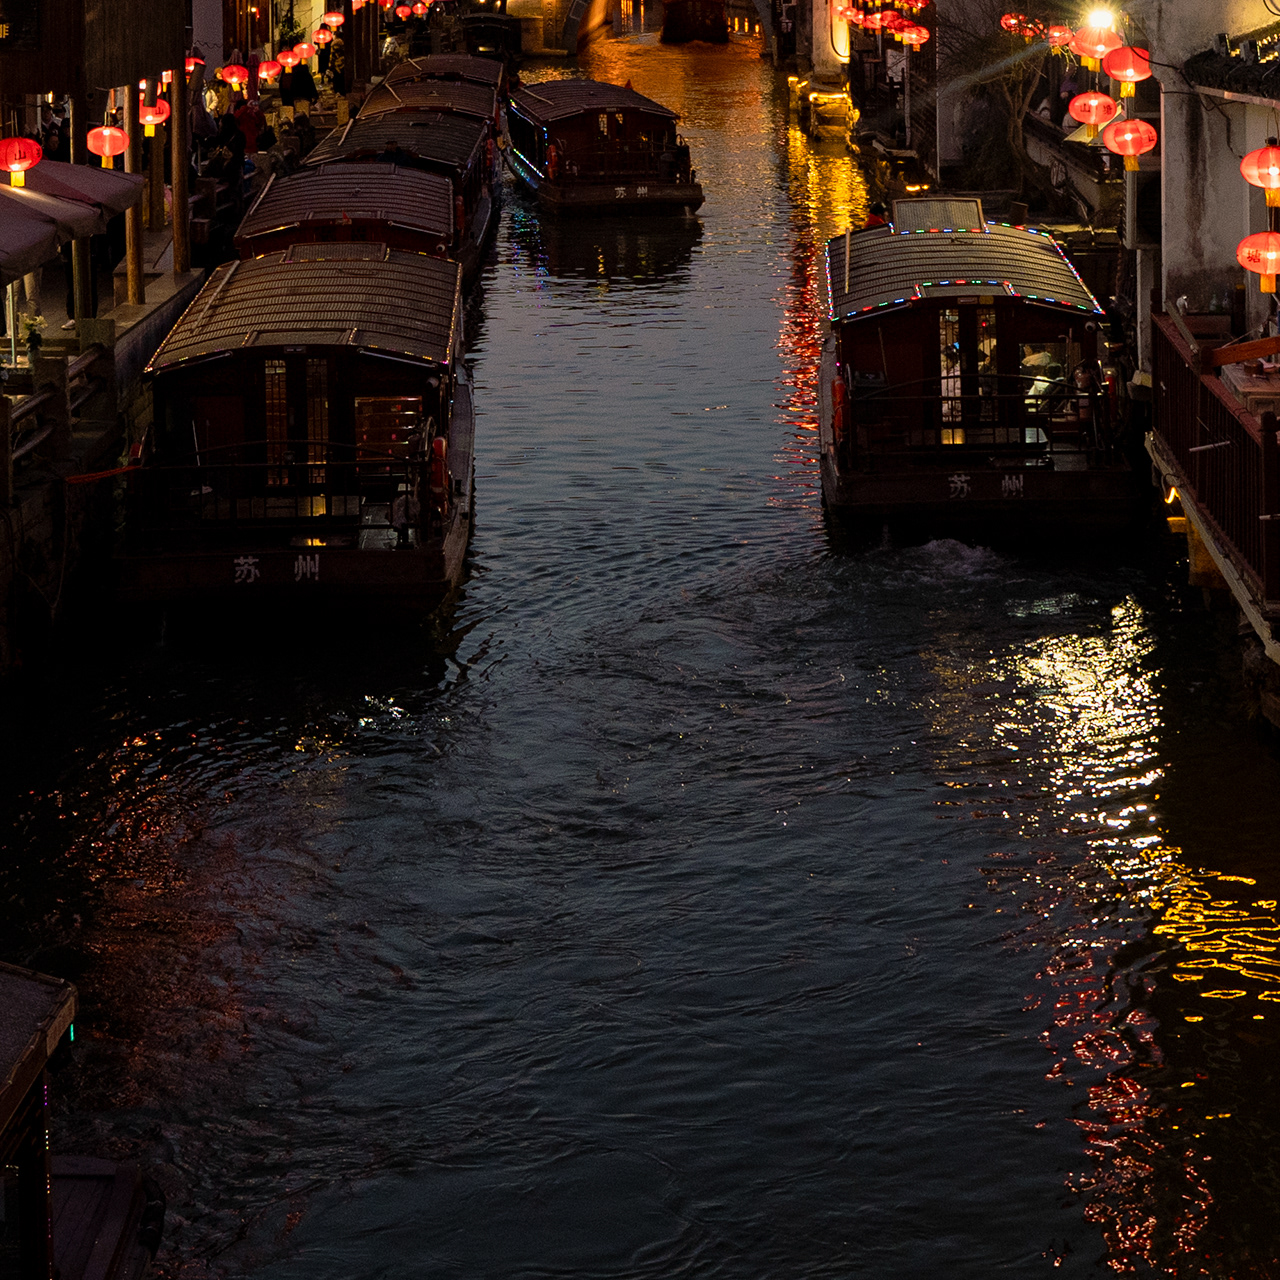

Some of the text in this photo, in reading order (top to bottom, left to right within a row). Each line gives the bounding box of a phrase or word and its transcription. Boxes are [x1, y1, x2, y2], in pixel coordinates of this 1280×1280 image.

[614, 186, 648, 199] 苏州
[948, 473, 1024, 500] 苏州
[233, 554, 320, 584] 苏州
